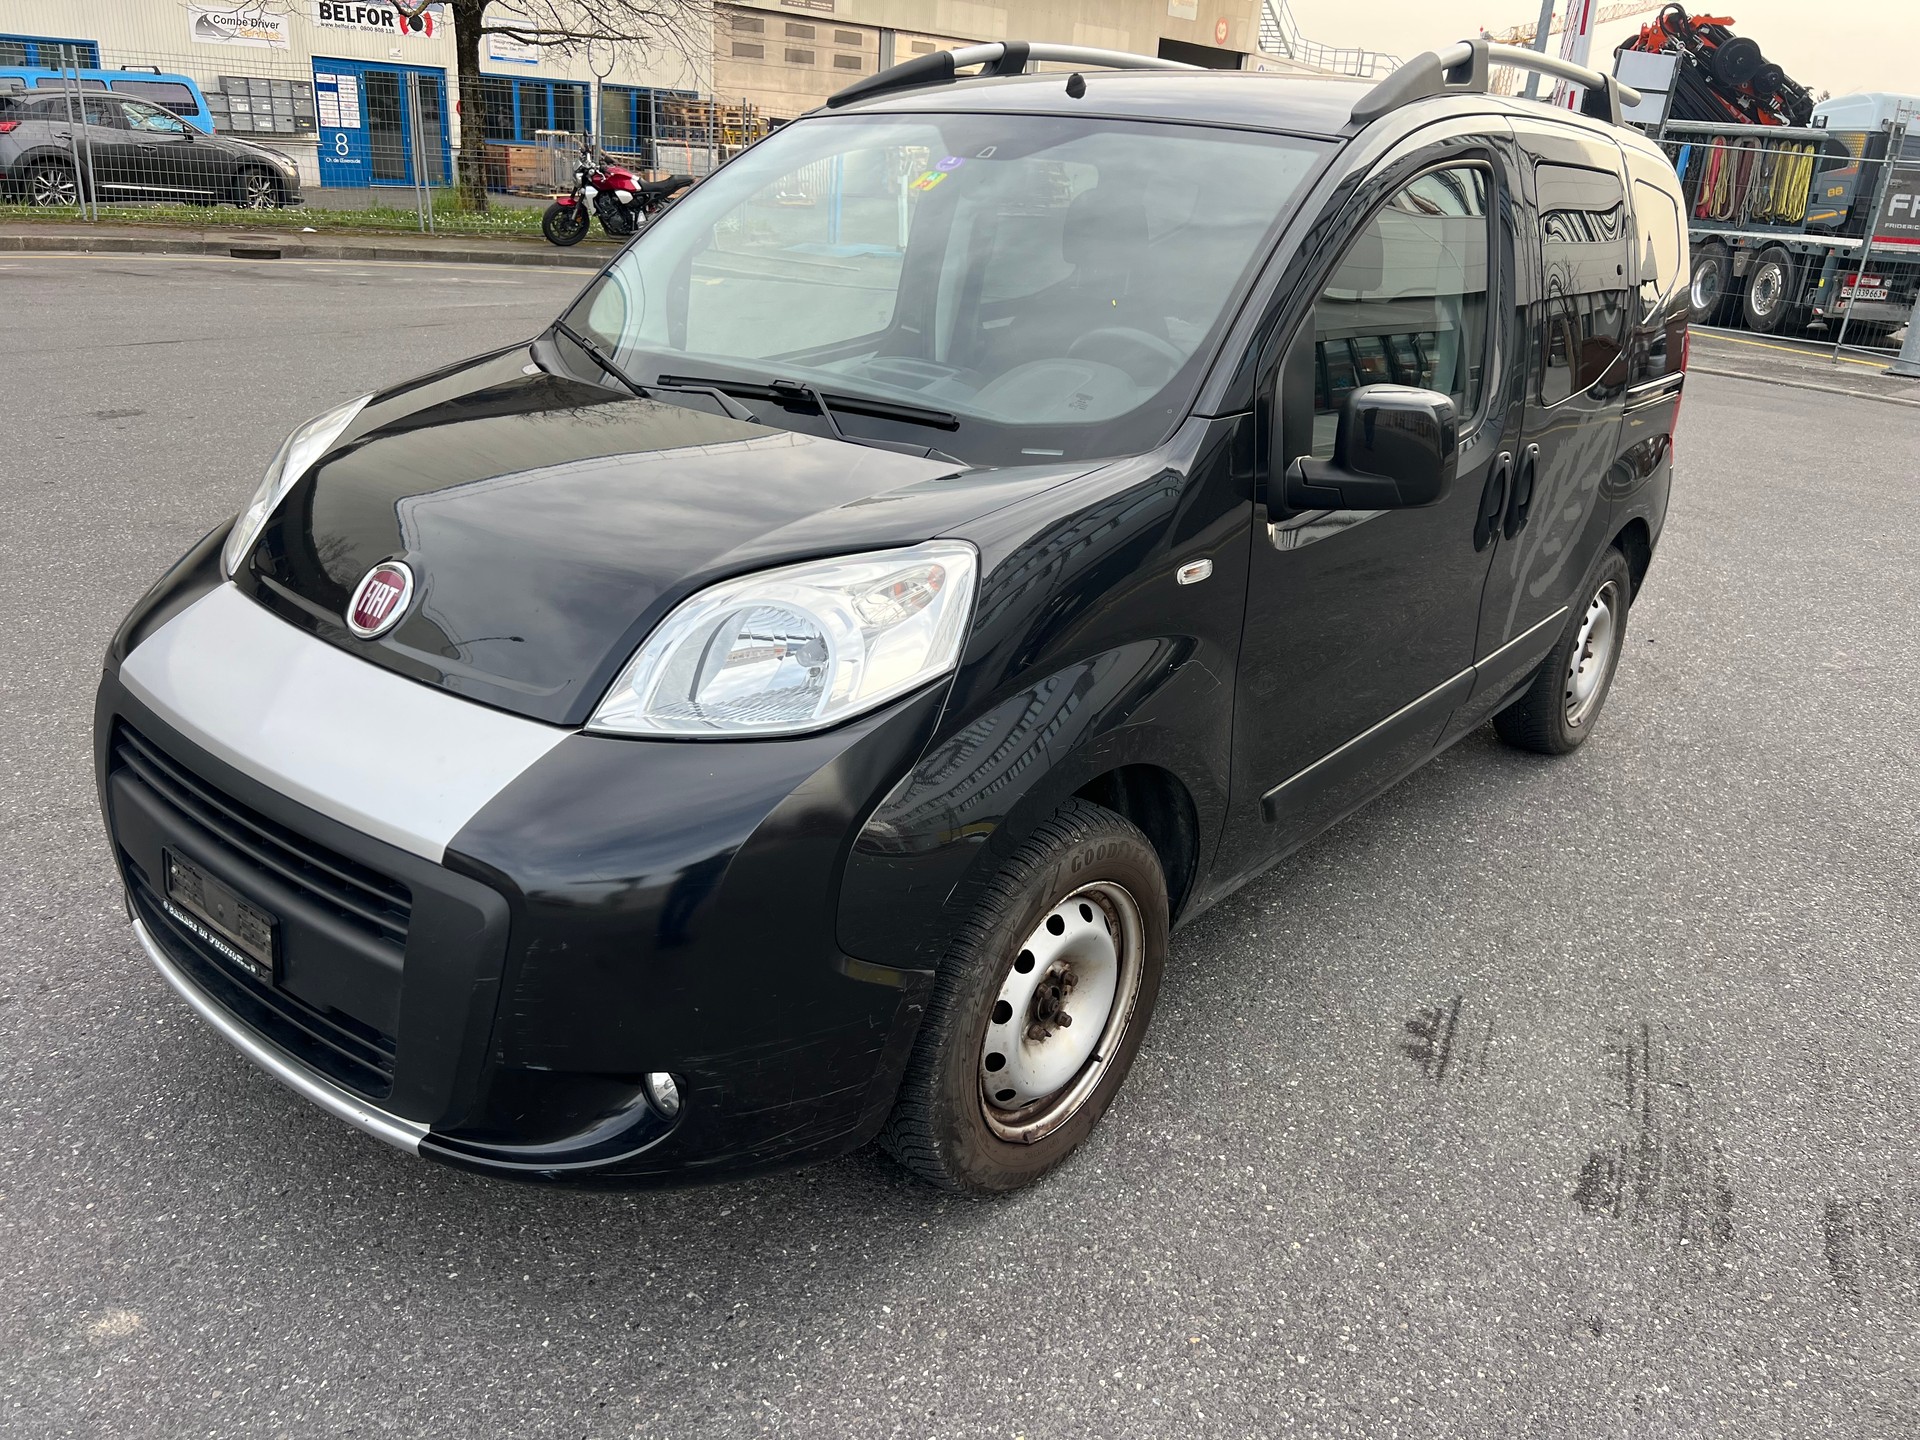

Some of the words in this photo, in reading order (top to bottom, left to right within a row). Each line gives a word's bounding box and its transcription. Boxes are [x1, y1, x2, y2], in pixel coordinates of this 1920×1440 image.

[213, 14, 248, 27] Combe
[251, 18, 280, 29] Driver
[319, 2, 394, 27] BELFOR
[240, 28, 279, 39] Services
[320, 22, 356, 30] www.belfor.ch
[335, 132, 349, 156] 8
[357, 579, 400, 619] FIAT
